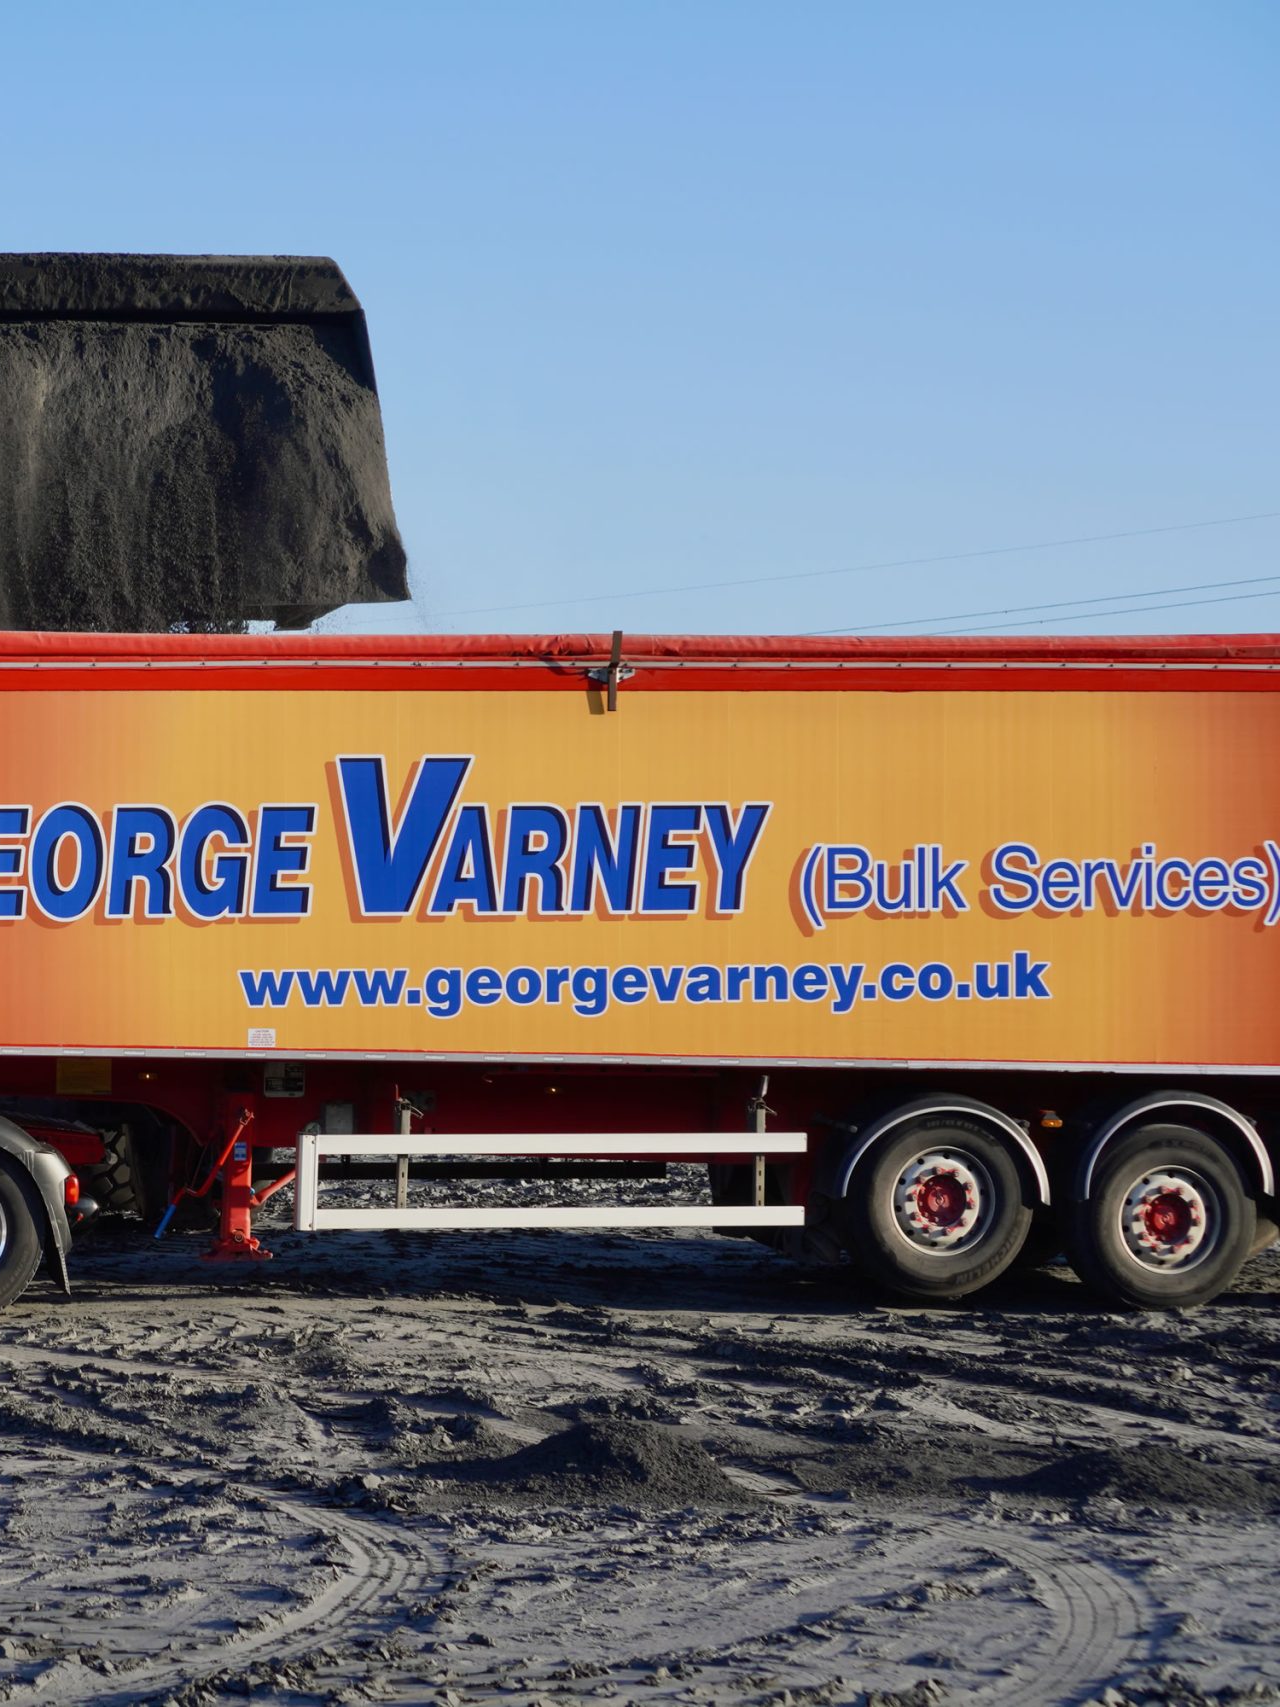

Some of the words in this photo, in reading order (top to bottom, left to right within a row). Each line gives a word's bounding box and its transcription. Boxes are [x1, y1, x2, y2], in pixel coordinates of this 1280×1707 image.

[334, 755, 773, 917] VARNEY
[799, 842, 970, 930] (Bulk
[990, 840, 1280, 926] Services)
[237, 949, 1053, 1020] www.georgevarney.co.uk
